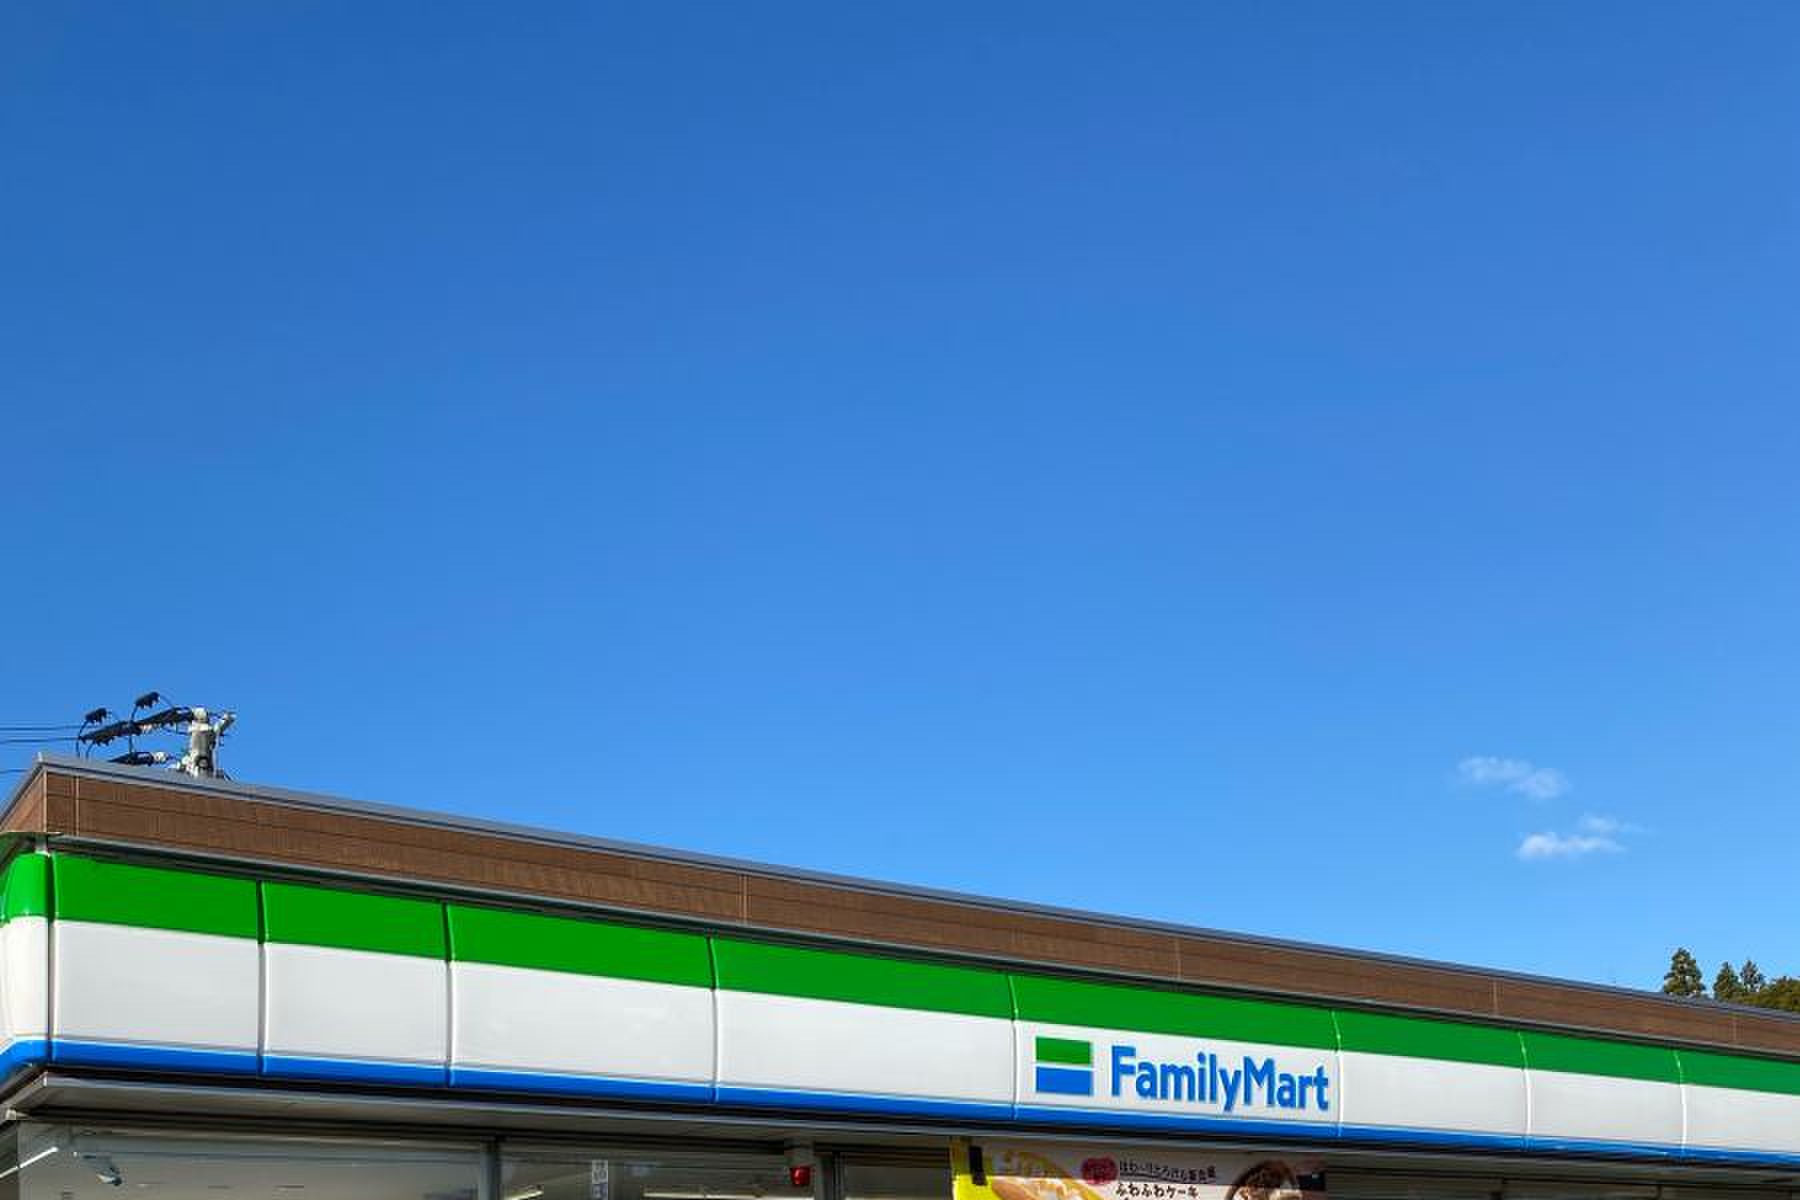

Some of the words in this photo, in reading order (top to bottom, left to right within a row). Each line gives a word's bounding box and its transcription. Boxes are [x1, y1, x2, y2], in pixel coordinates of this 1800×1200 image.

[1111, 1045, 1328, 1112] FamilyMart
[1115, 1184, 1199, 1199] ふわふわケーキ
